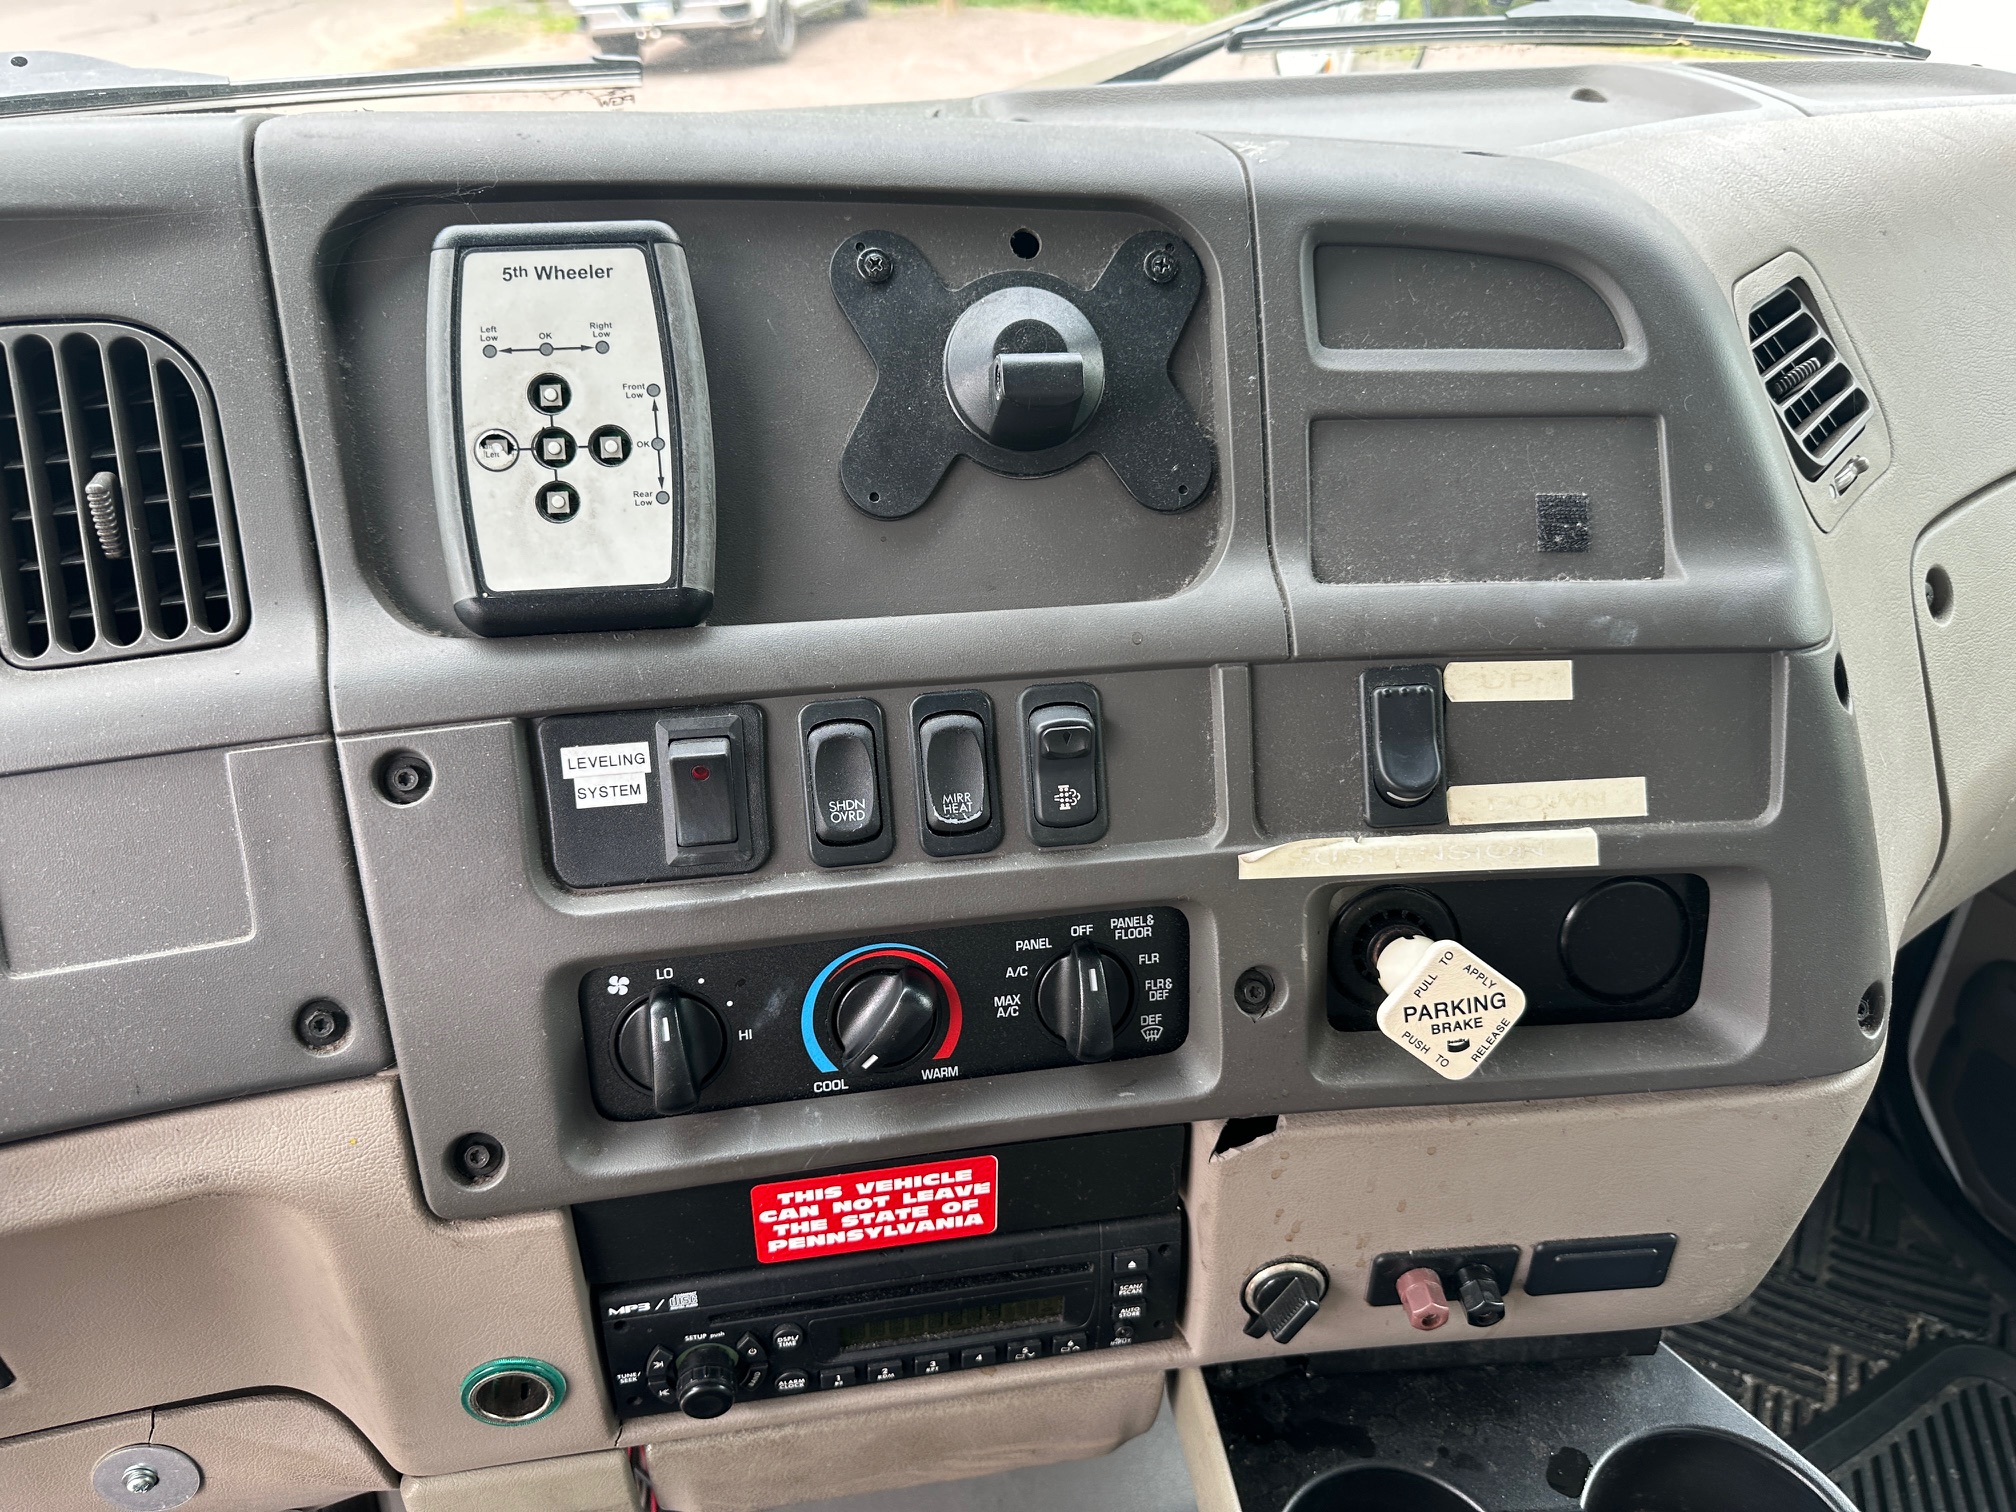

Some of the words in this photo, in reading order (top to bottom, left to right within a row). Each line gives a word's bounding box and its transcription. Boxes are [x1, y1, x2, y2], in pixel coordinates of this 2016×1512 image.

[501, 265, 529, 282] 5th
[534, 264, 614, 281] Wheeler
[480, 325, 498, 334] Left
[589, 321, 613, 332] Right
[479, 334, 499, 342] Low
[538, 331, 553, 340] OK
[592, 329, 611, 338] Low
[622, 382, 646, 392] Front
[625, 391, 644, 399] Low
[636, 440, 651, 448] OK
[633, 489, 653, 498] Rear
[634, 498, 653, 506] Low
[567, 750, 647, 772] LEVELING
[577, 782, 643, 801] SYSTEM
[942, 792, 973, 806] MIRR
[828, 799, 866, 814] SHDN
[943, 801, 974, 815] HEAT
[830, 808, 866, 823] OVRD
[1110, 914, 1155, 930] PANEL&
[1070, 924, 1094, 937] OFF
[1115, 927, 1152, 940] FLOOR
[1015, 938, 1053, 951] PANEL
[1138, 953, 1160, 965] FLR
[655, 968, 674, 981] LO
[1005, 966, 1029, 978] A/C
[1413, 974, 1438, 998] PULL
[1438, 950, 1454, 966] TO
[1462, 963, 1498, 990] APPLY
[993, 994, 1022, 1008] MAX
[1149, 990, 1170, 1001] DEF
[996, 1005, 1020, 1018] A/C
[1403, 992, 1507, 1024] PARKING
[1140, 1013, 1163, 1026] DEF
[1430, 1016, 1484, 1036] BRAKE
[738, 1028, 753, 1041] HI
[1401, 1031, 1431, 1054] PUSH
[1435, 1053, 1450, 1068] TO
[1471, 1018, 1511, 1063] RELEASE
[921, 1065, 960, 1081] WARM
[813, 1078, 849, 1093] COOL
[777, 1185, 843, 1206] THIS
[855, 1168, 973, 1195] VEHICLE
[758, 1204, 820, 1224] CAN
[832, 1194, 891, 1215] NOT
[902, 1181, 991, 1205] LEAVE
[772, 1218, 829, 1238] THE
[840, 1205, 930, 1229] STATE
[940, 1198, 980, 1216] OF
[766, 1213, 985, 1253] PENNSYLVANIA
[607, 1302, 651, 1316] MP3
[684, 1332, 708, 1342] SETUP
[710, 1331, 726, 1340] push
[778, 1339, 798, 1348] TIME
[975, 1353, 983, 1362] 4
[619, 1376, 638, 1384] SEEK
[777, 1377, 806, 1387] ALARM
[778, 1382, 806, 1391] CLOCK
